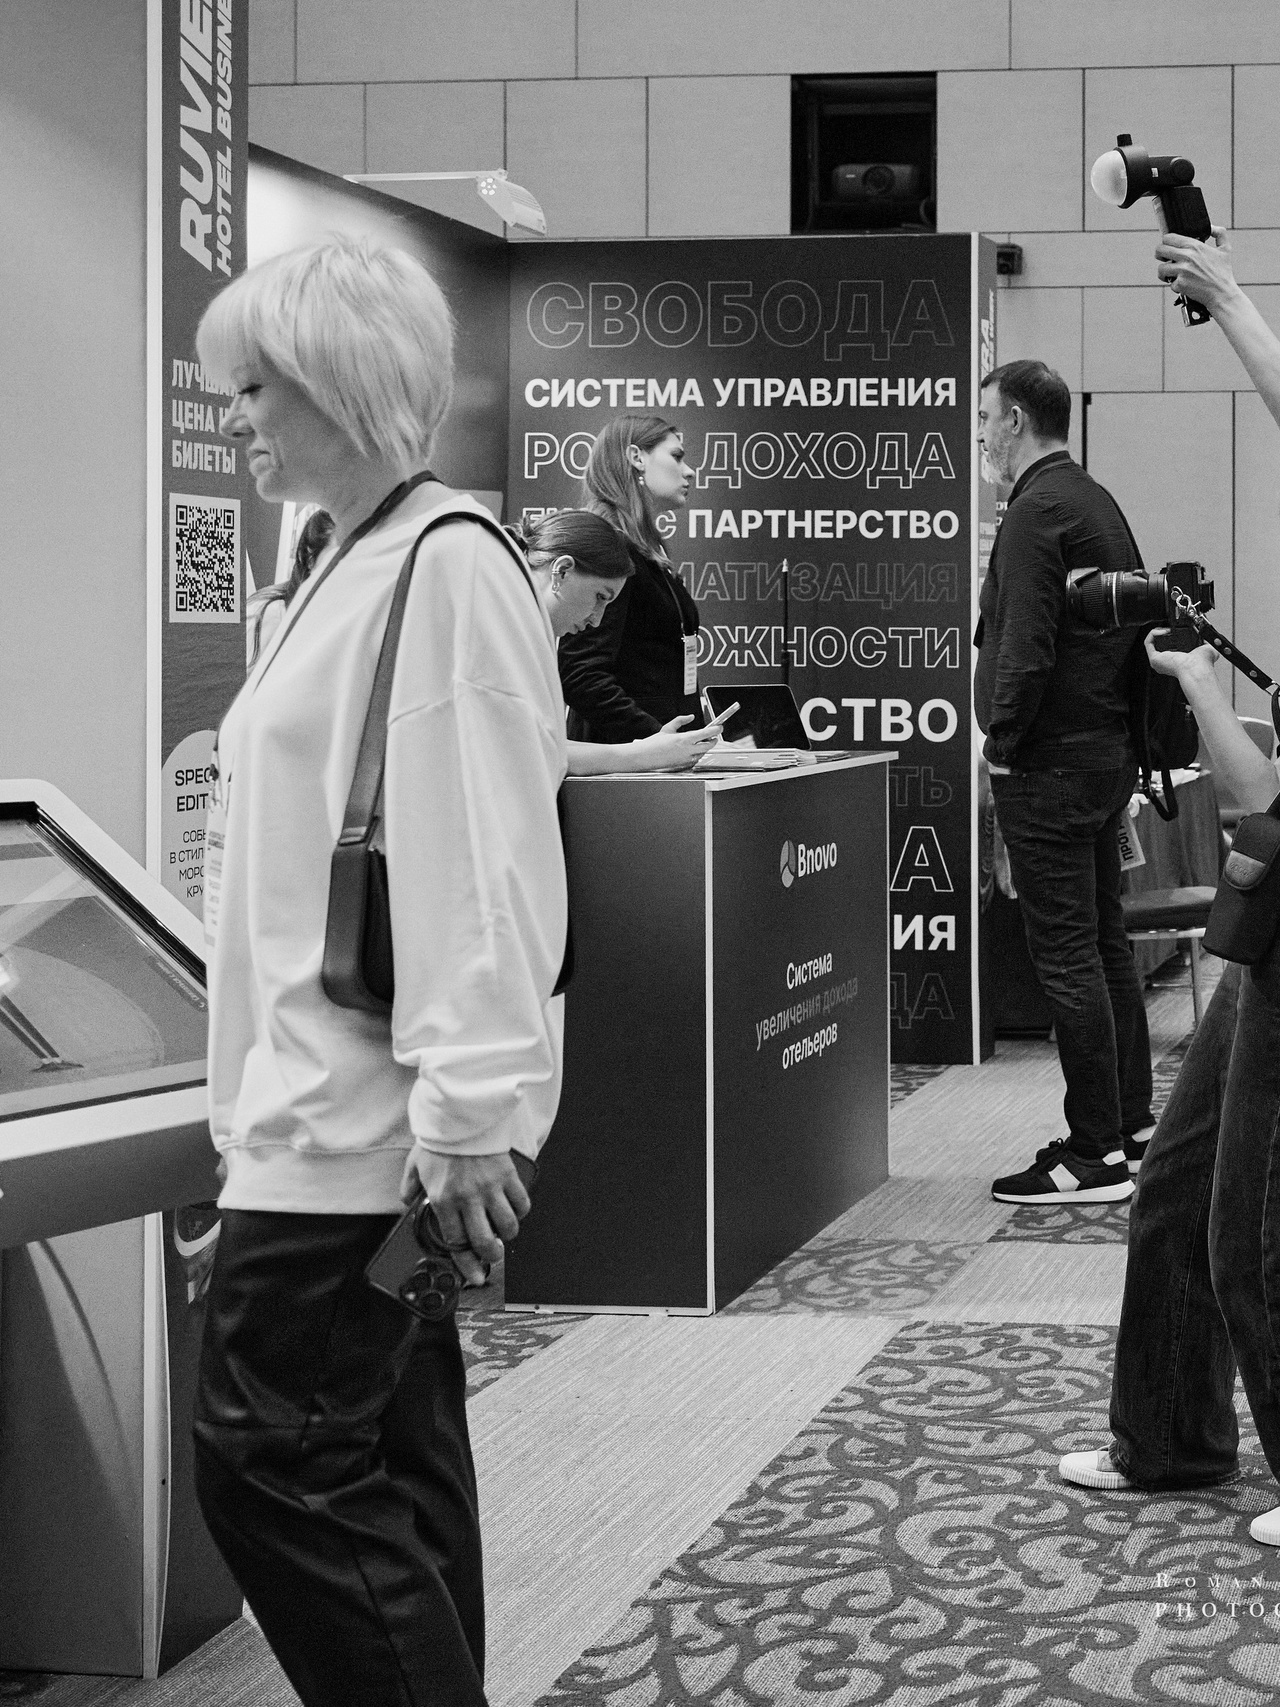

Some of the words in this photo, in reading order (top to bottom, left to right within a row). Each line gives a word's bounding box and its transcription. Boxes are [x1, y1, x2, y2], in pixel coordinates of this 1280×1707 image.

[180, 0, 213, 272] RUVIE
[216, 146, 232, 278] HOTEL
[526, 279, 956, 362] СВОБОДА
[172, 359, 236, 398] ЛУЧ
[524, 378, 705, 408] СИСТЕМА
[713, 377, 957, 407] УПРАВЛЕНИЯ
[172, 399, 216, 434] ЦЕНА
[172, 439, 236, 475] БИЛЕТЫ
[695, 432, 956, 489] ДОХОДА
[688, 509, 959, 540] ПАРТНЕРСТВО
[797, 842, 838, 878] Bnovo
[786, 952, 833, 990] Система
[755, 994, 821, 1051] увеличения
[822, 976, 859, 1016] дохода
[782, 1022, 838, 1070] отельеров
